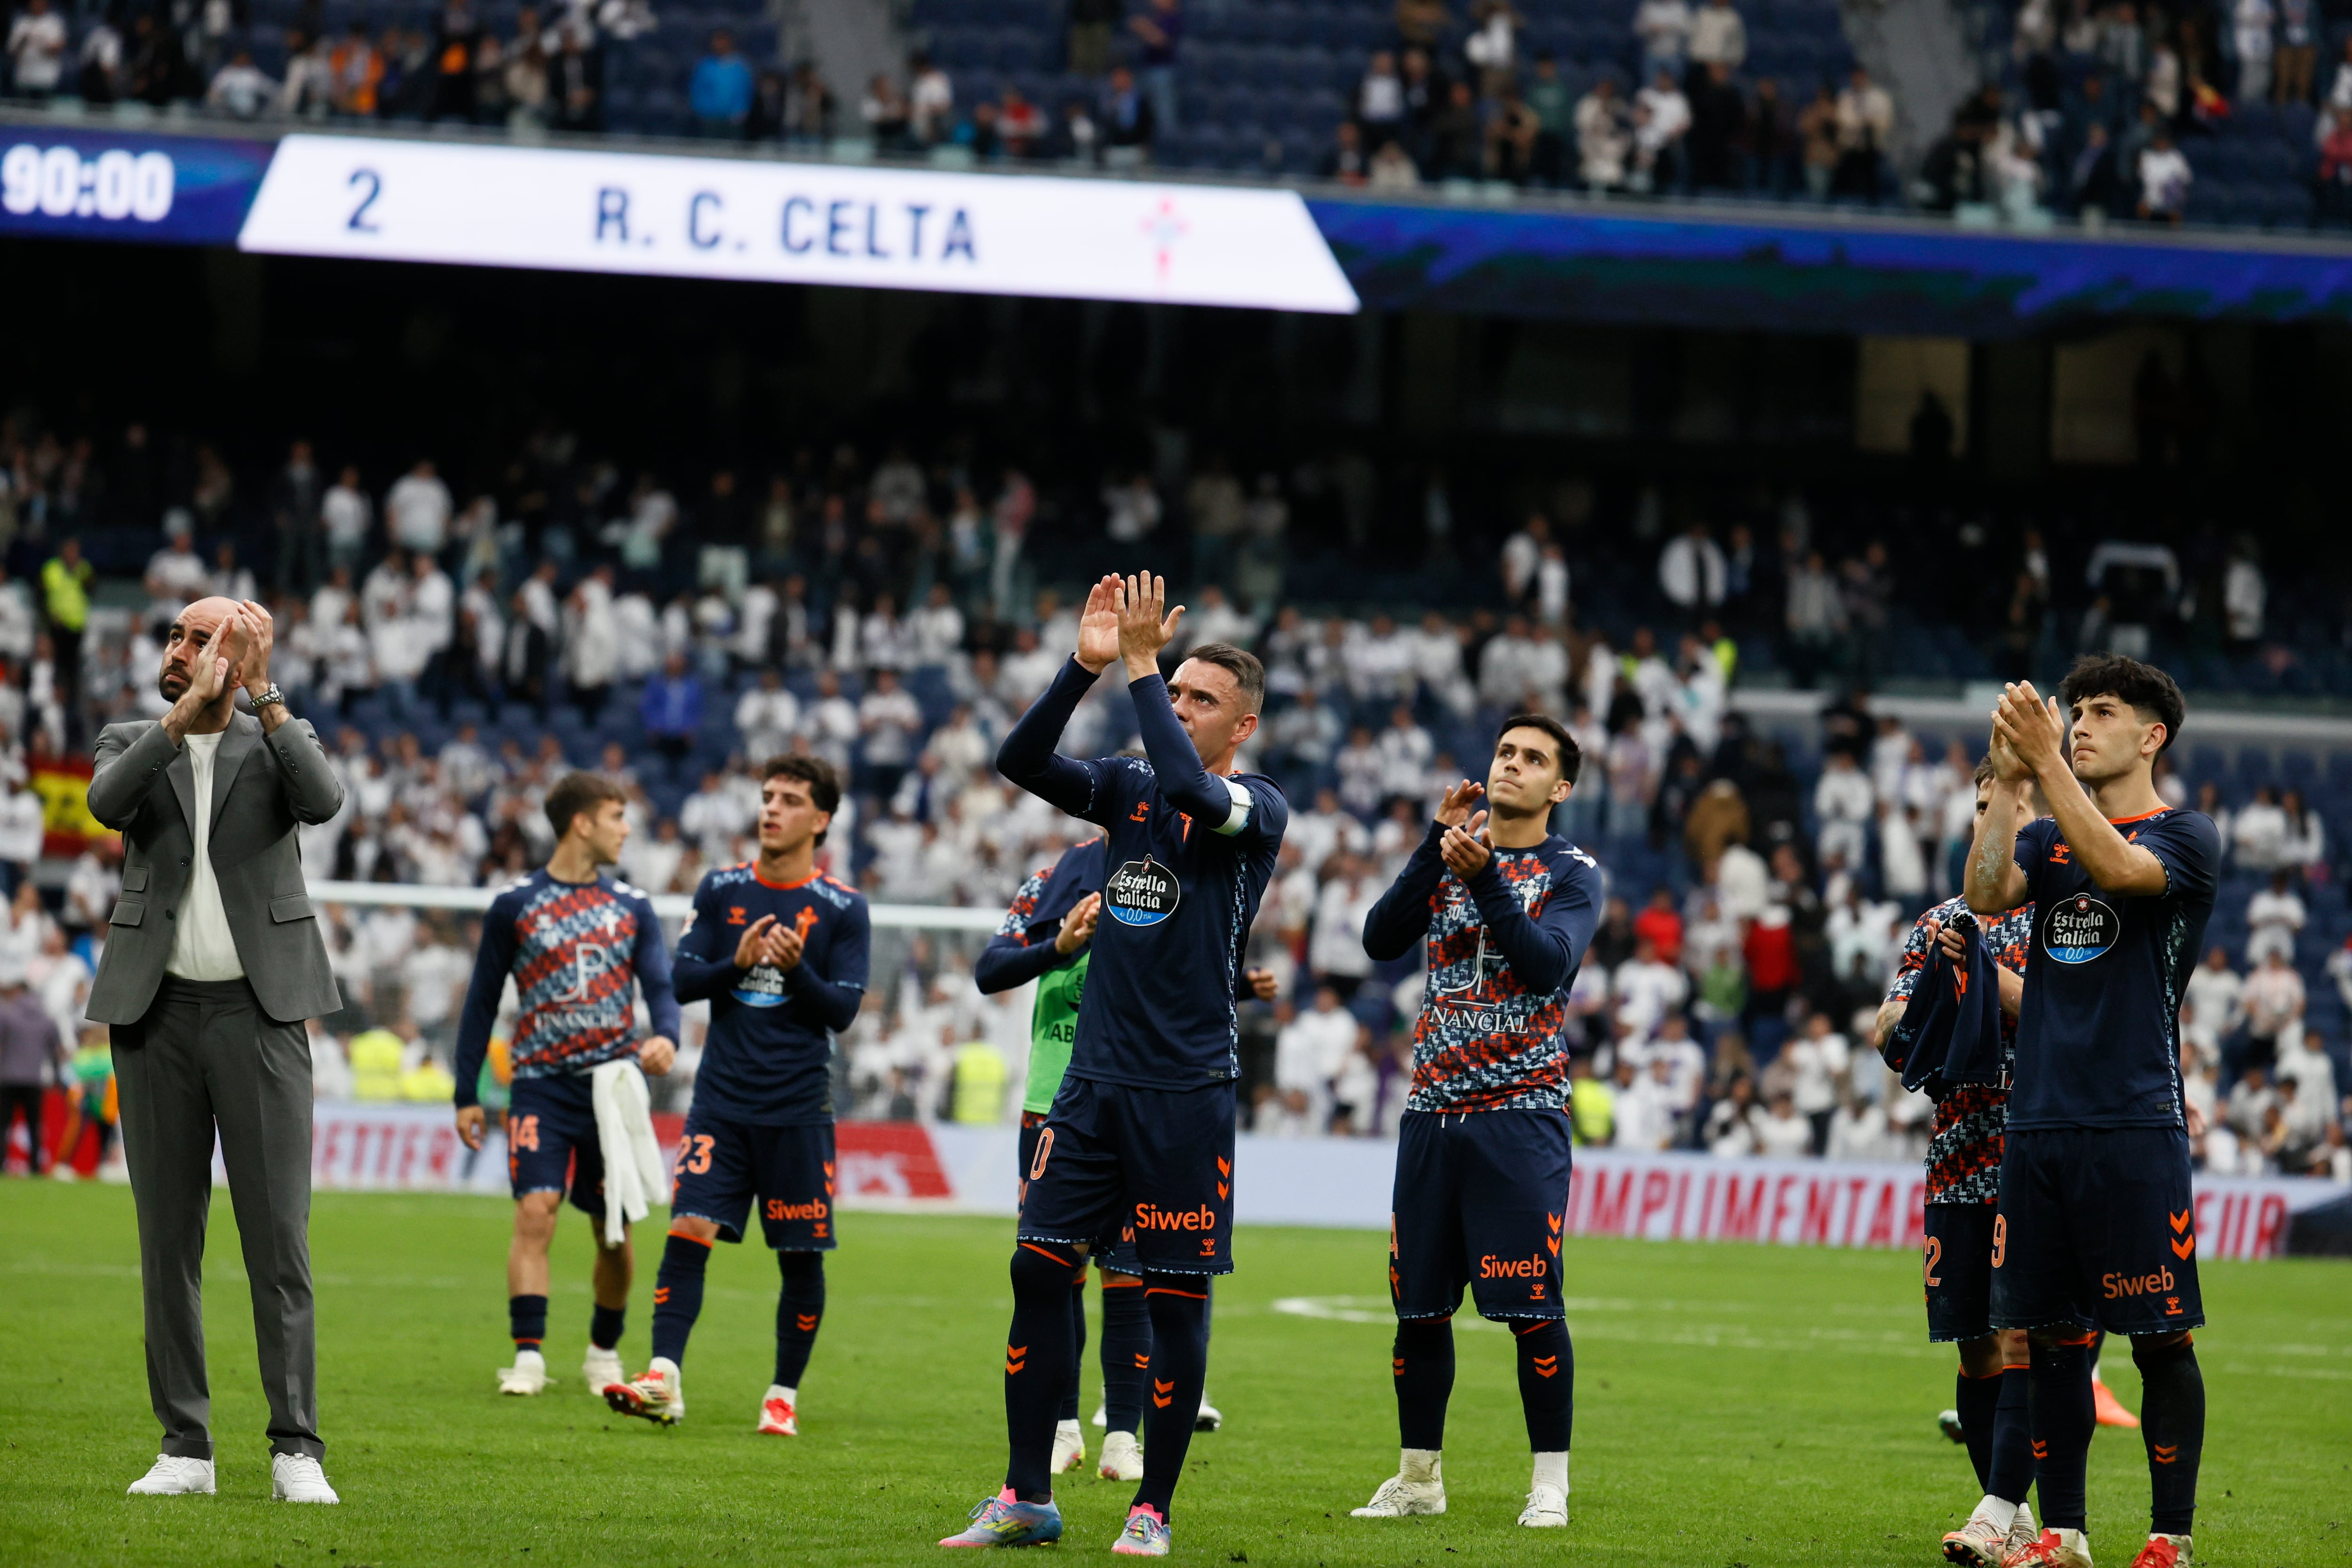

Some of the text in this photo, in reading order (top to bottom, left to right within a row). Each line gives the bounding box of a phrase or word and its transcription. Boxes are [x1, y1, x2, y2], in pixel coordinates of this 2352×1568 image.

[1, 143, 175, 222] 90:00
[348, 168, 381, 233] 2
[596, 187, 977, 259] R. C. CELTA
[1118, 870, 1167, 892] Estrella
[1116, 887, 1160, 909] Galicia
[1127, 907, 1143, 922] 0,0
[1444, 904, 1462, 921] 30
[2053, 911, 2104, 929] Estrella
[2053, 928, 2100, 946] Galicia
[2065, 947, 2084, 961] 0,0
[509, 1114, 540, 1154] 14
[311, 1119, 457, 1182] ETTER
[674, 1134, 715, 1175] 23
[766, 1198, 828, 1220] Siweb
[1136, 1203, 1216, 1231] Siweb
[1991, 1214, 2006, 1268] 9
[1480, 1254, 1547, 1279] Siweb
[2102, 1265, 2175, 1299] Siweb
